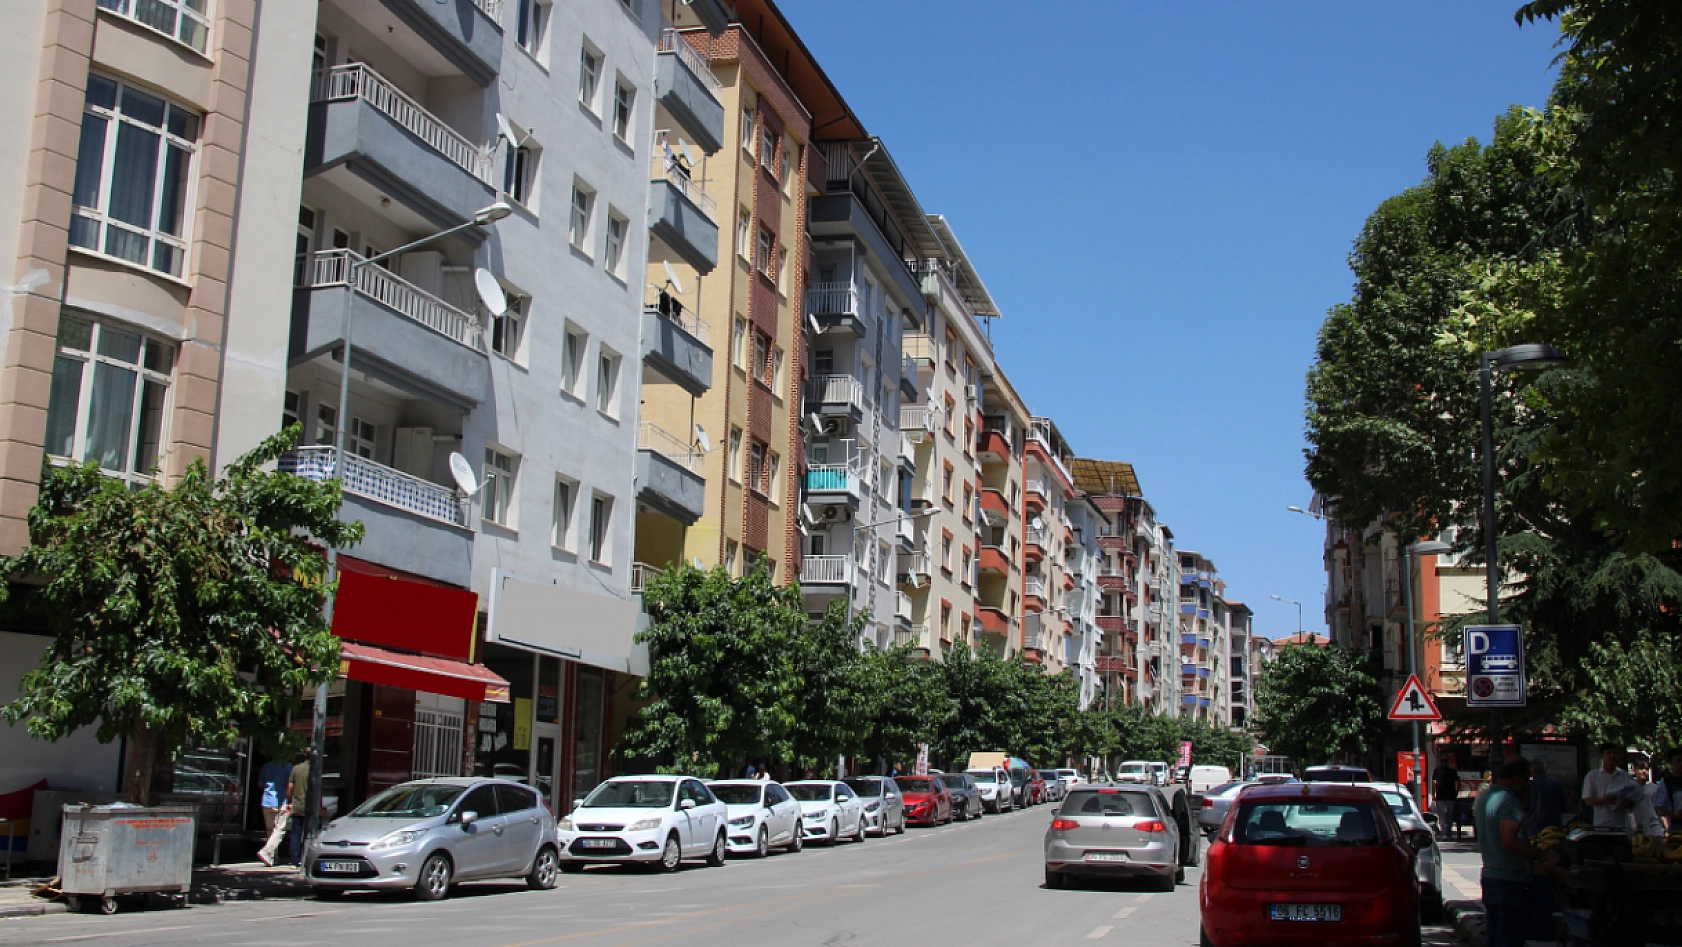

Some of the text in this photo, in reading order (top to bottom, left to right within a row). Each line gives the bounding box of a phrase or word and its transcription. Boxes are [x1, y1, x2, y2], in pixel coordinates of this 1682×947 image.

[1470, 631, 1490, 654] D
[1296, 905, 1309, 917] FC
[1314, 905, 1339, 918] 5516
